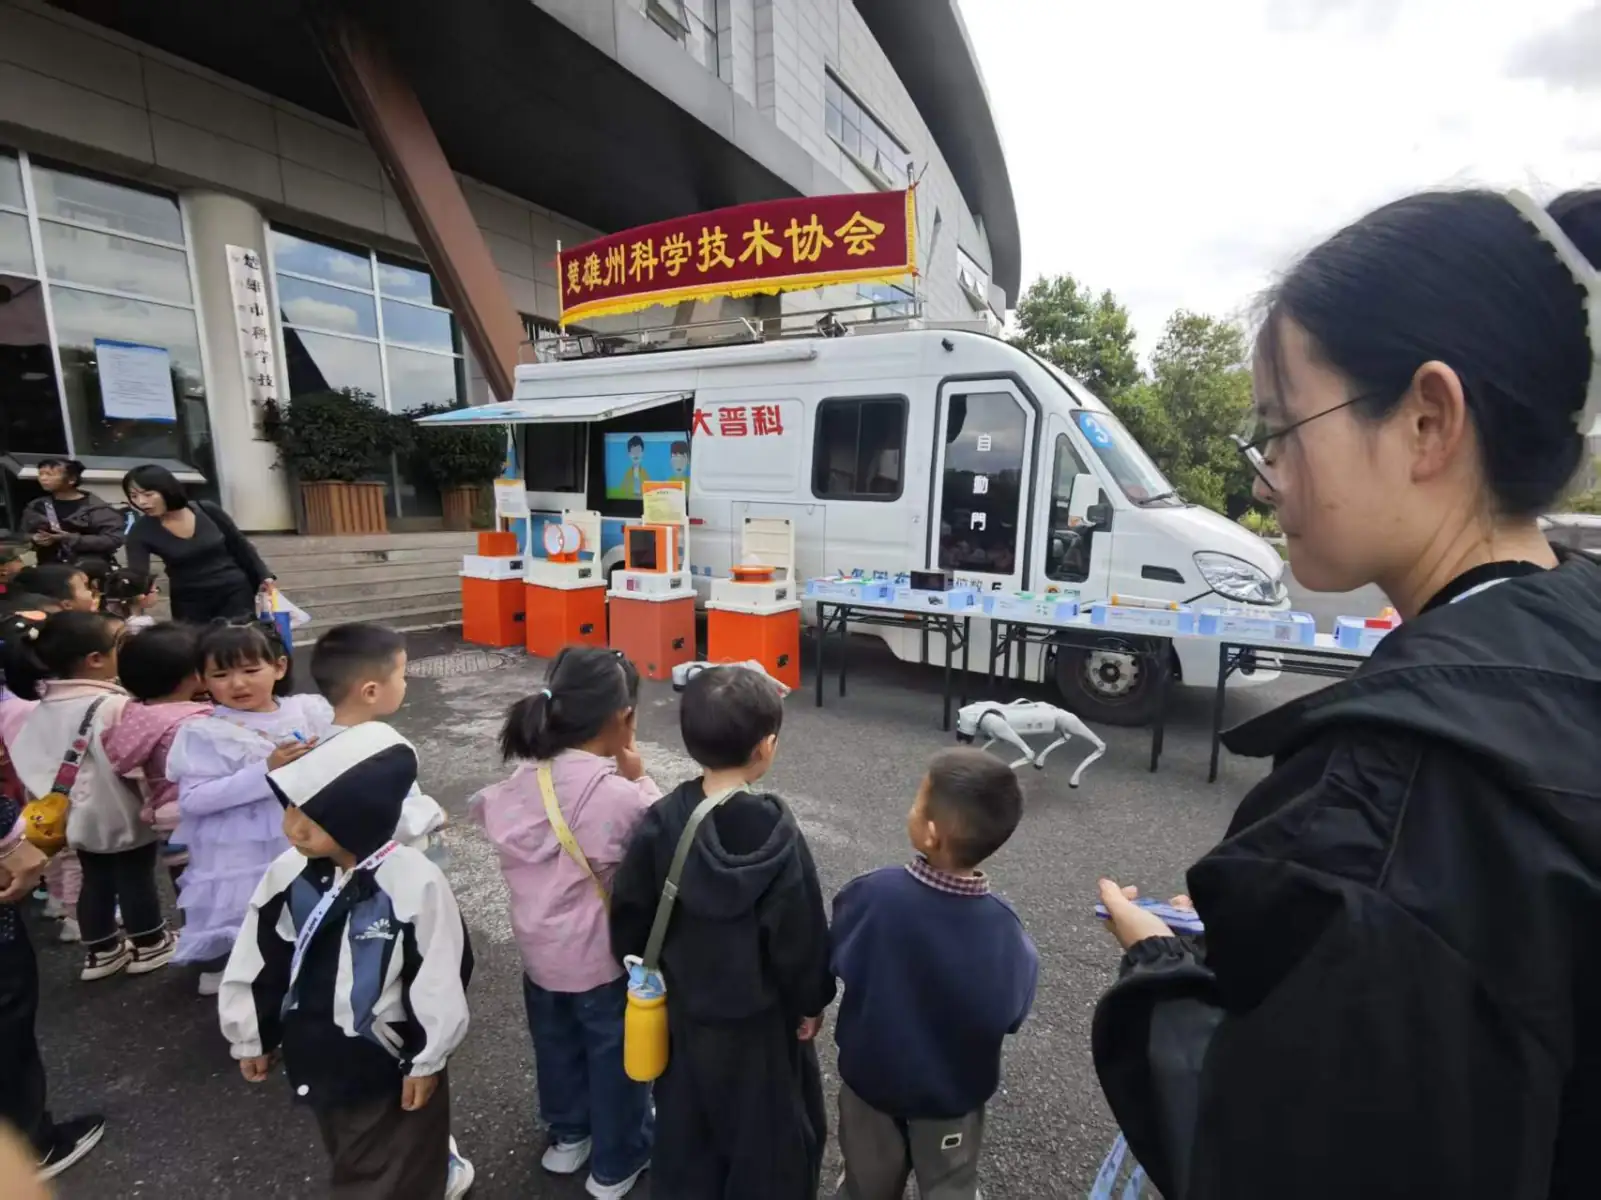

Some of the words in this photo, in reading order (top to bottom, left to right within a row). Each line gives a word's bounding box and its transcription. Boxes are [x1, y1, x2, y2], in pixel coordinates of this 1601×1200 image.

[566, 210, 885, 296] 楚雄州科学技术协会
[1085, 416, 1109, 444] 3
